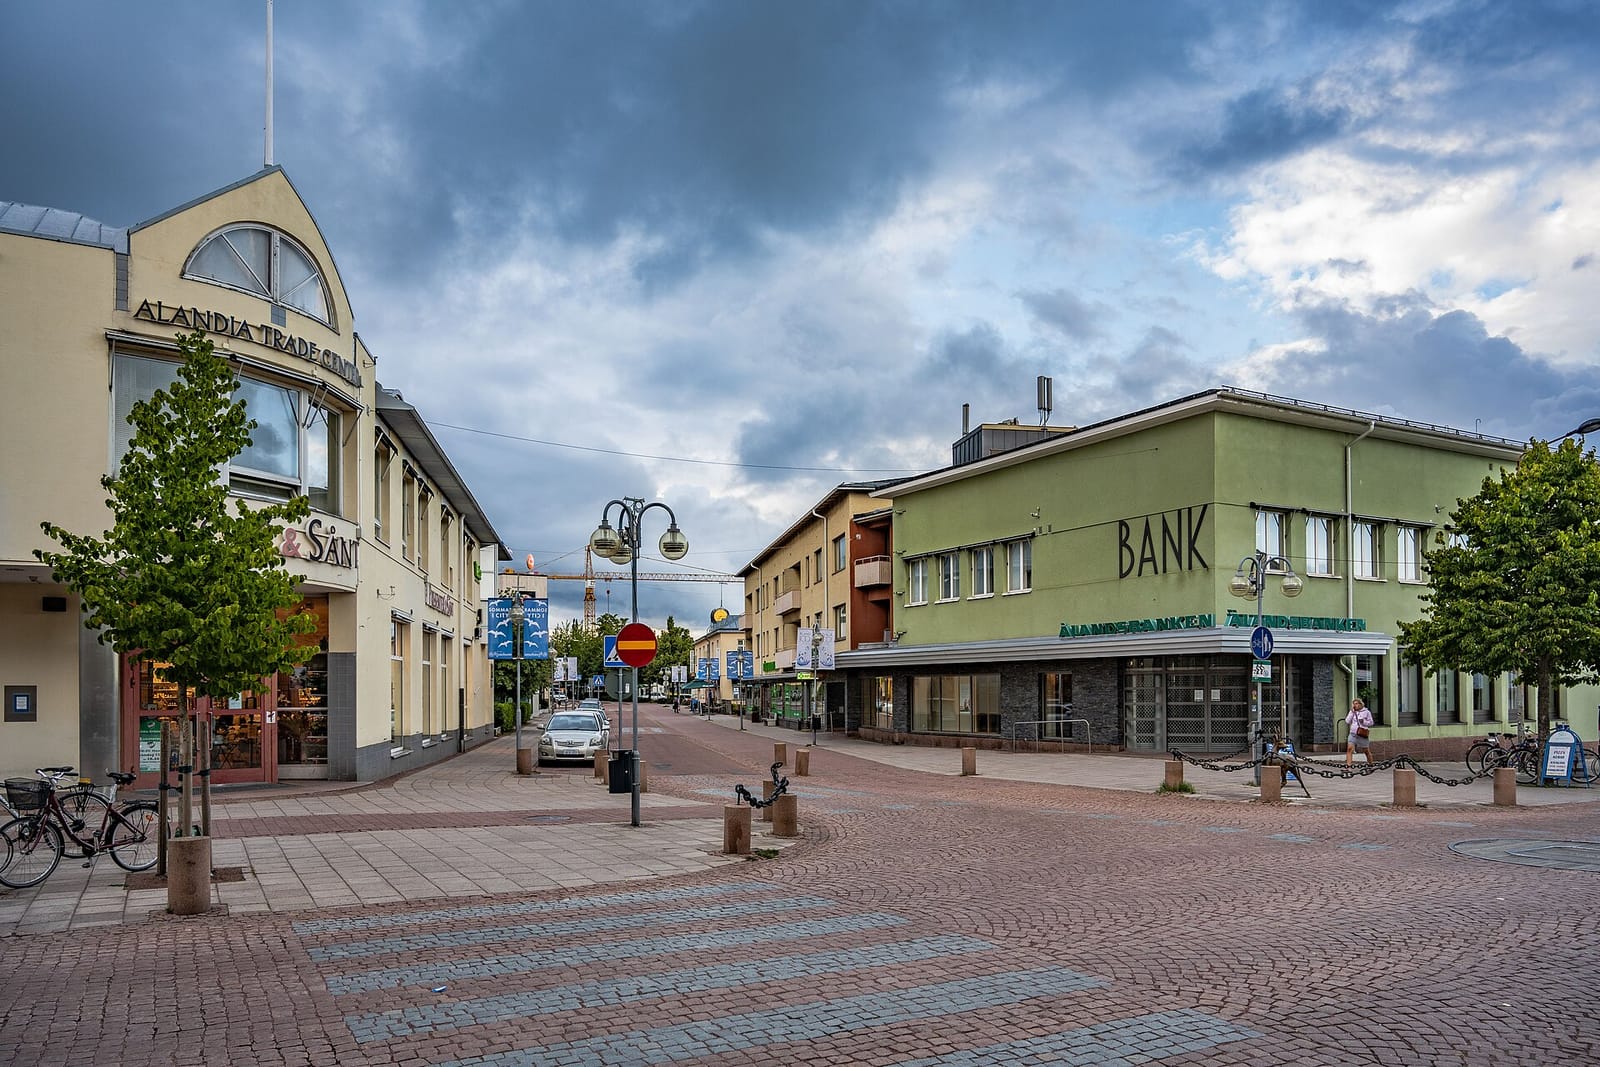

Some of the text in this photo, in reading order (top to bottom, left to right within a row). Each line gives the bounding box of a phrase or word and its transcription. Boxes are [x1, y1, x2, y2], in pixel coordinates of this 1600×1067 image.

[133, 298, 254, 341] ALANDIA
[260, 324, 321, 361] TRADE
[279, 527, 302, 557] &
[1118, 503, 1208, 579] BANK
[1059, 614, 1215, 638] ÅLANDSBANKEN
